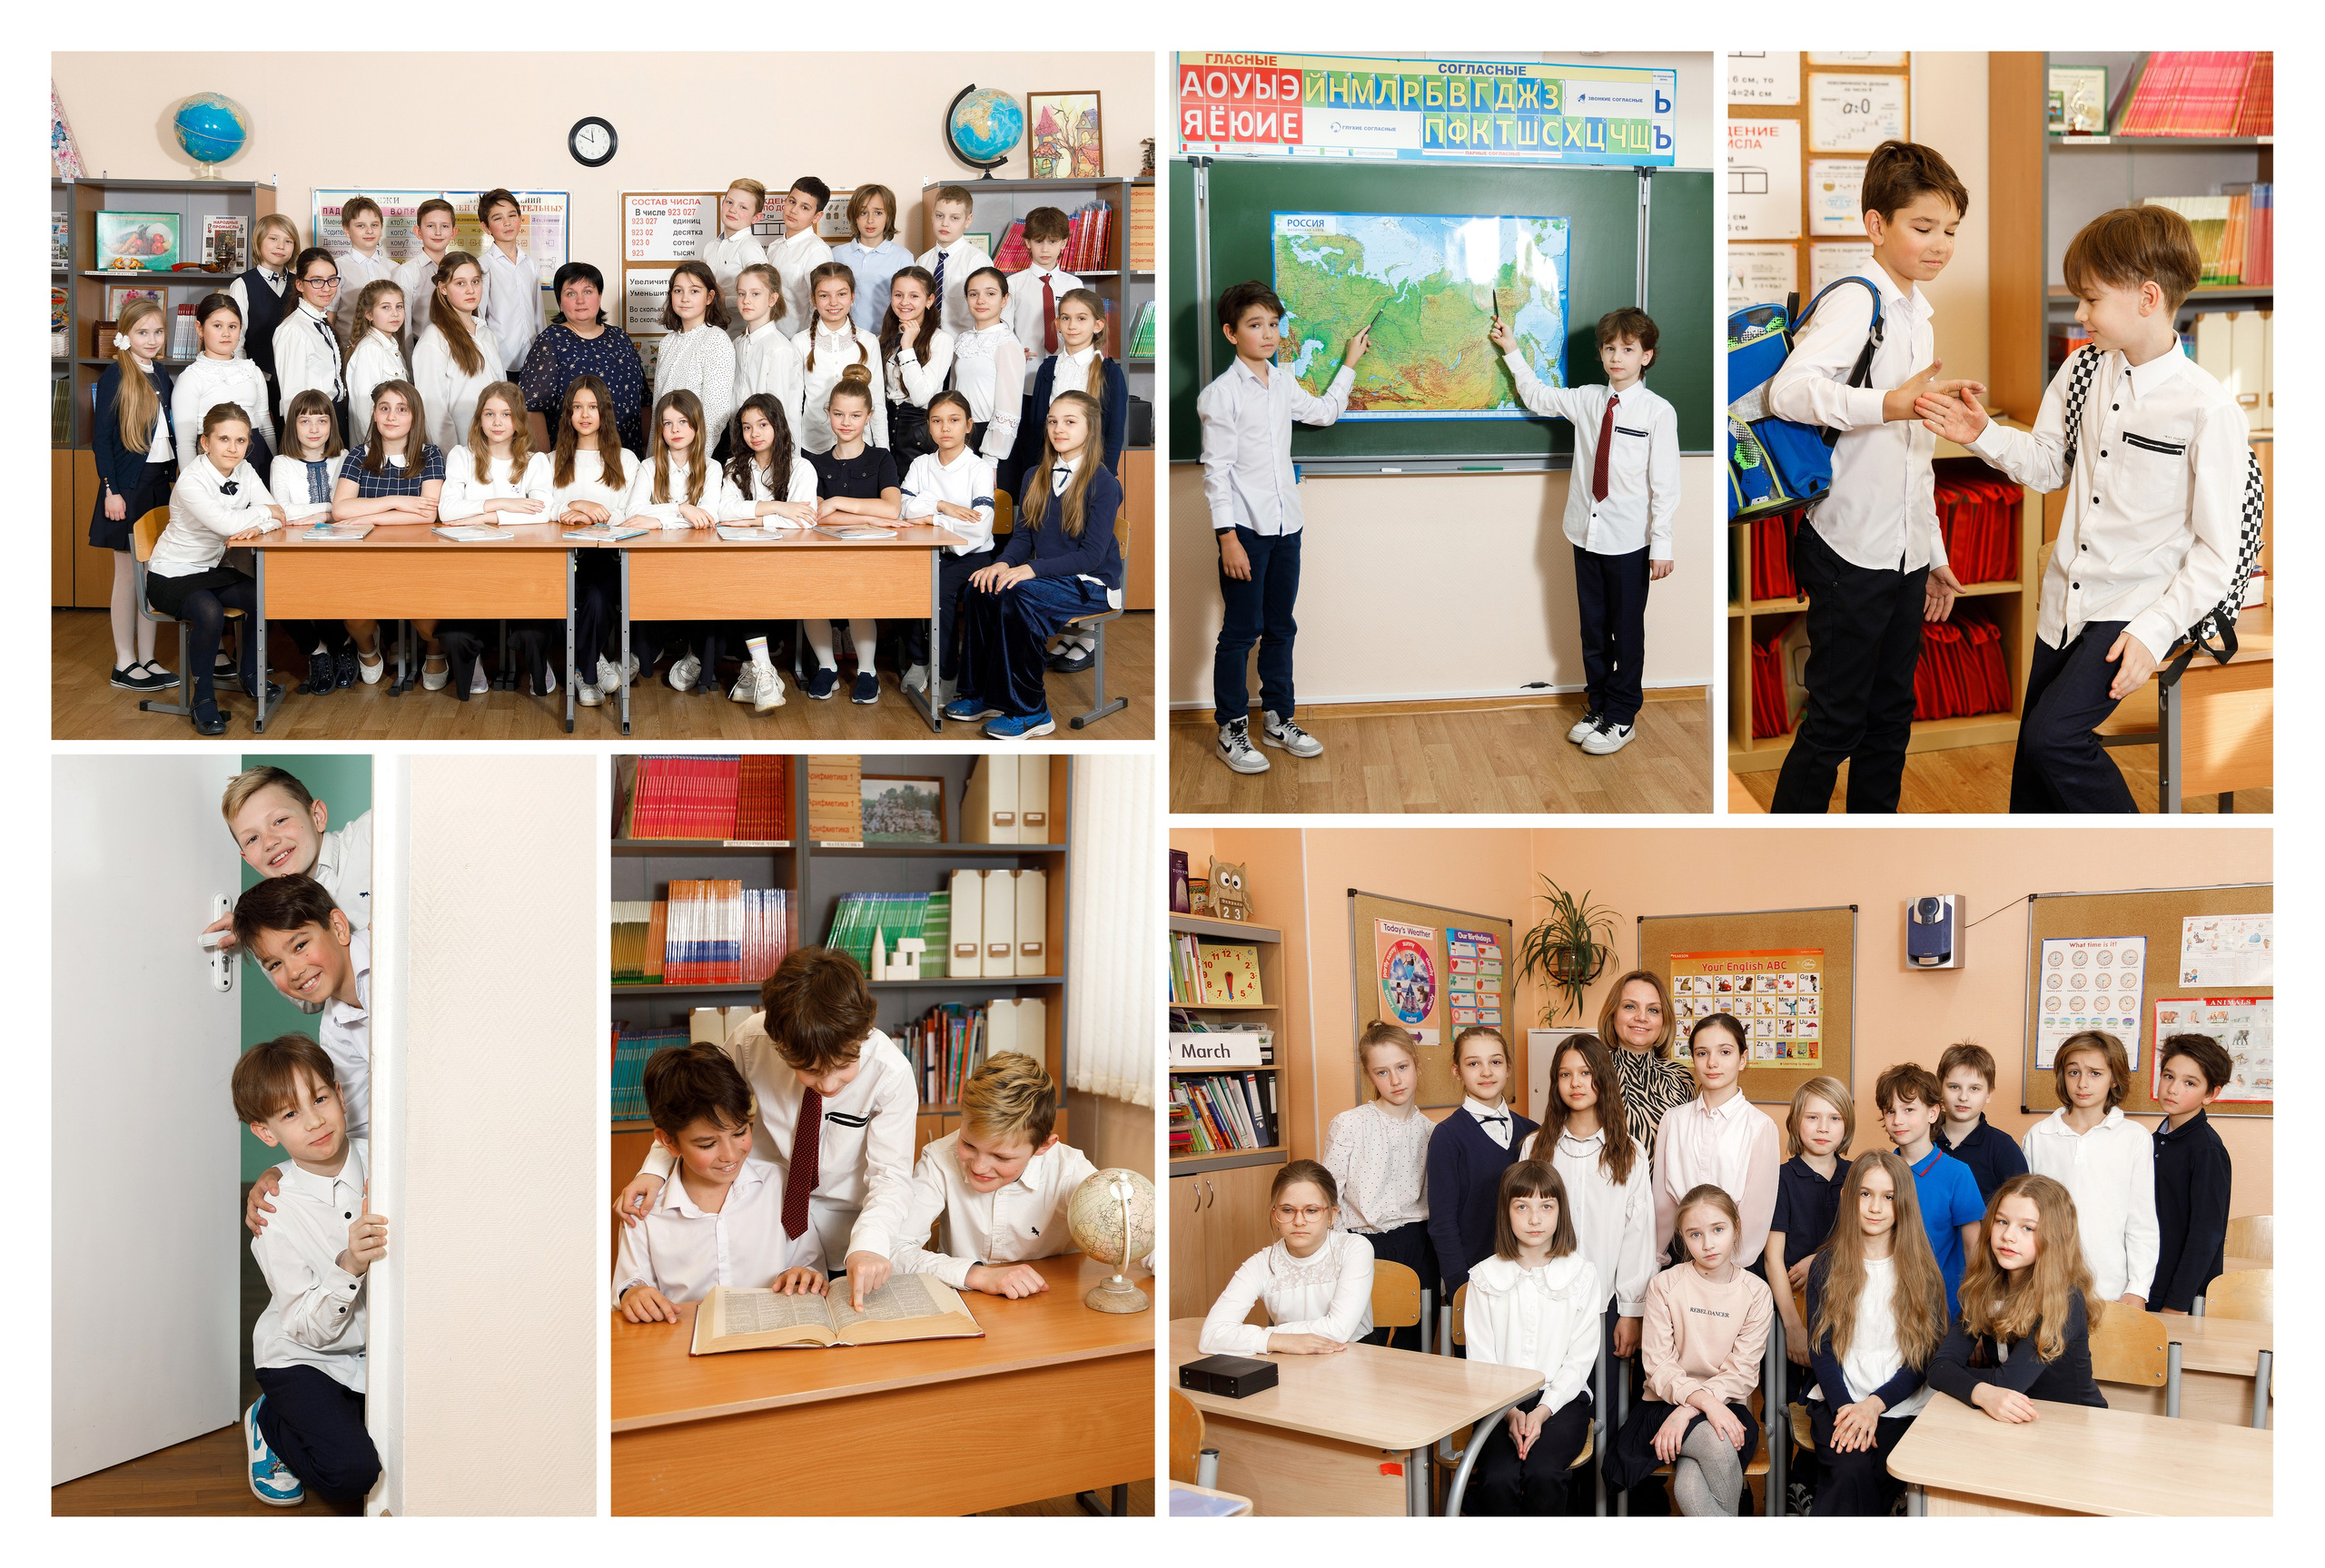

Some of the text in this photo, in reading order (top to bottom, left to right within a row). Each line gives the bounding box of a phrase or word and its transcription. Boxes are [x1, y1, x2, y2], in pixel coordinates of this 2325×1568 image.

[1205, 54, 1277, 66] ГЛАСНЫЕ
[1439, 64, 1527, 76] СОГЛАСНЫЕ
[1384, 923, 1430, 938] Today's Weather
[1469, 933, 1491, 943] Birthdays
[1425, 958, 1433, 976] cloudy
[1701, 961, 1787, 973] Your English ABC
[1182, 1043, 1231, 1058] March
